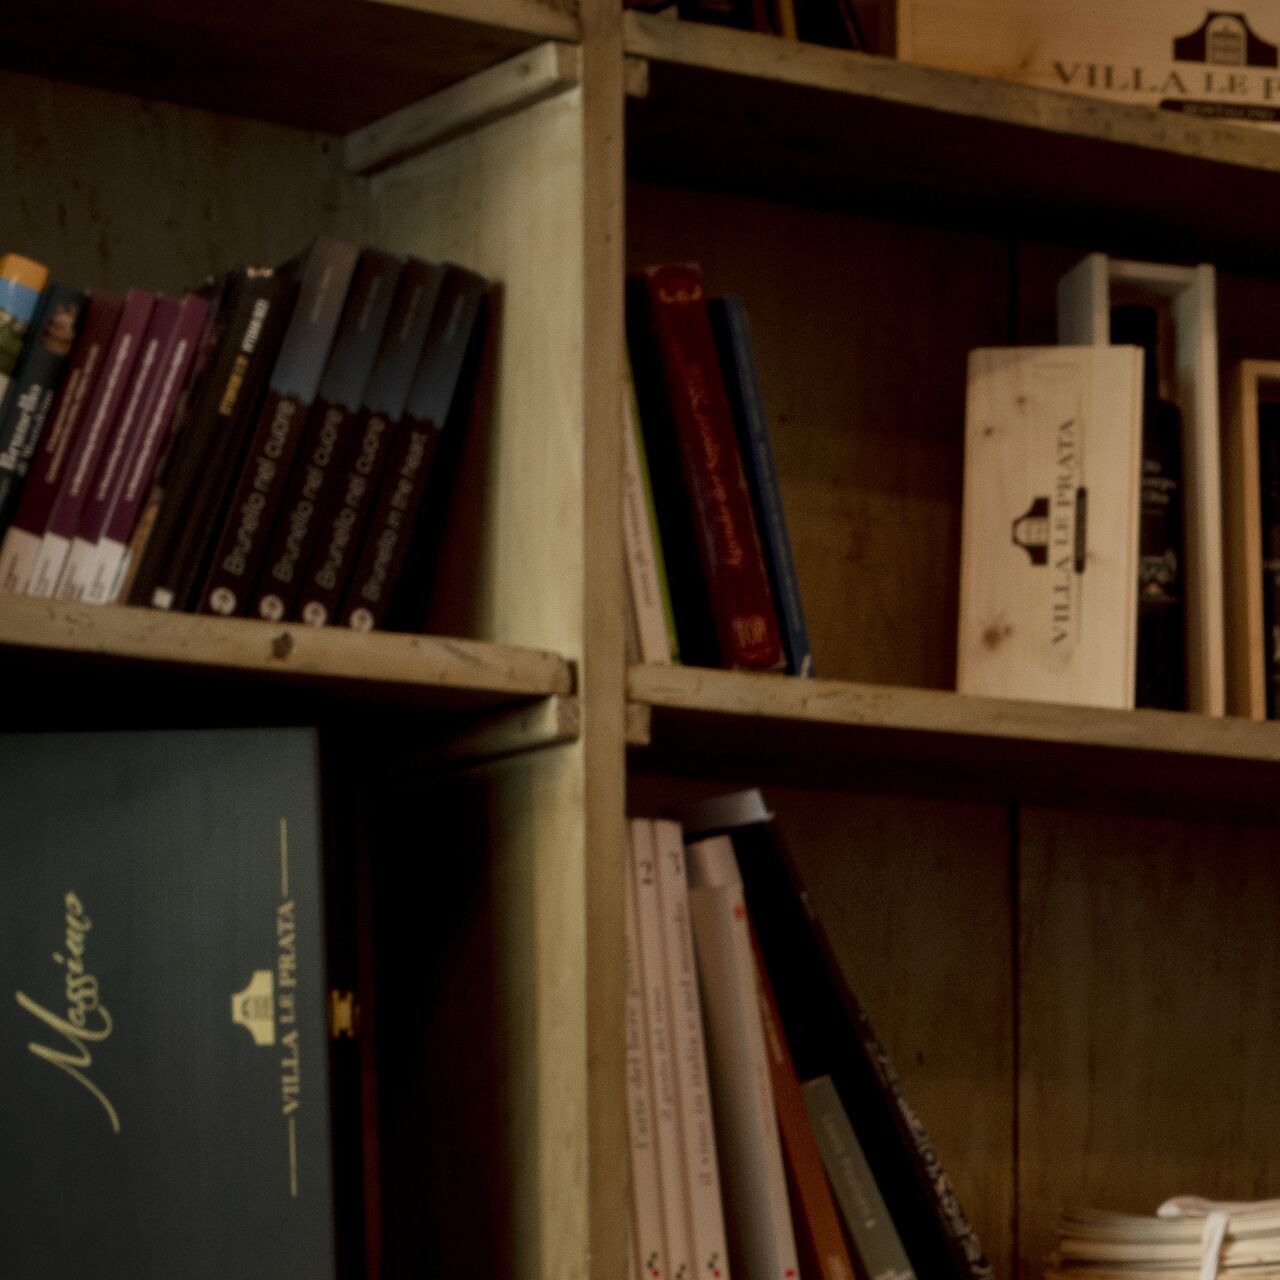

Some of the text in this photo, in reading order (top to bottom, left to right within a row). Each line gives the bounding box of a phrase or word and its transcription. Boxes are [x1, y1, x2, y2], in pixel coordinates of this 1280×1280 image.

[1053, 60, 1188, 96] VILLA
[1204, 70, 1249, 95] LE
[222, 400, 295, 576] Brunello nel cuore
[272, 408, 343, 582] Brunello nel cuore
[316, 416, 385, 590] Brunello nel cuore
[1055, 418, 1074, 508] PRATA
[361, 528, 397, 602] Brunello
[1052, 554, 1070, 645] VILLA
[278, 900, 299, 1116] VILLA LE PRATA
